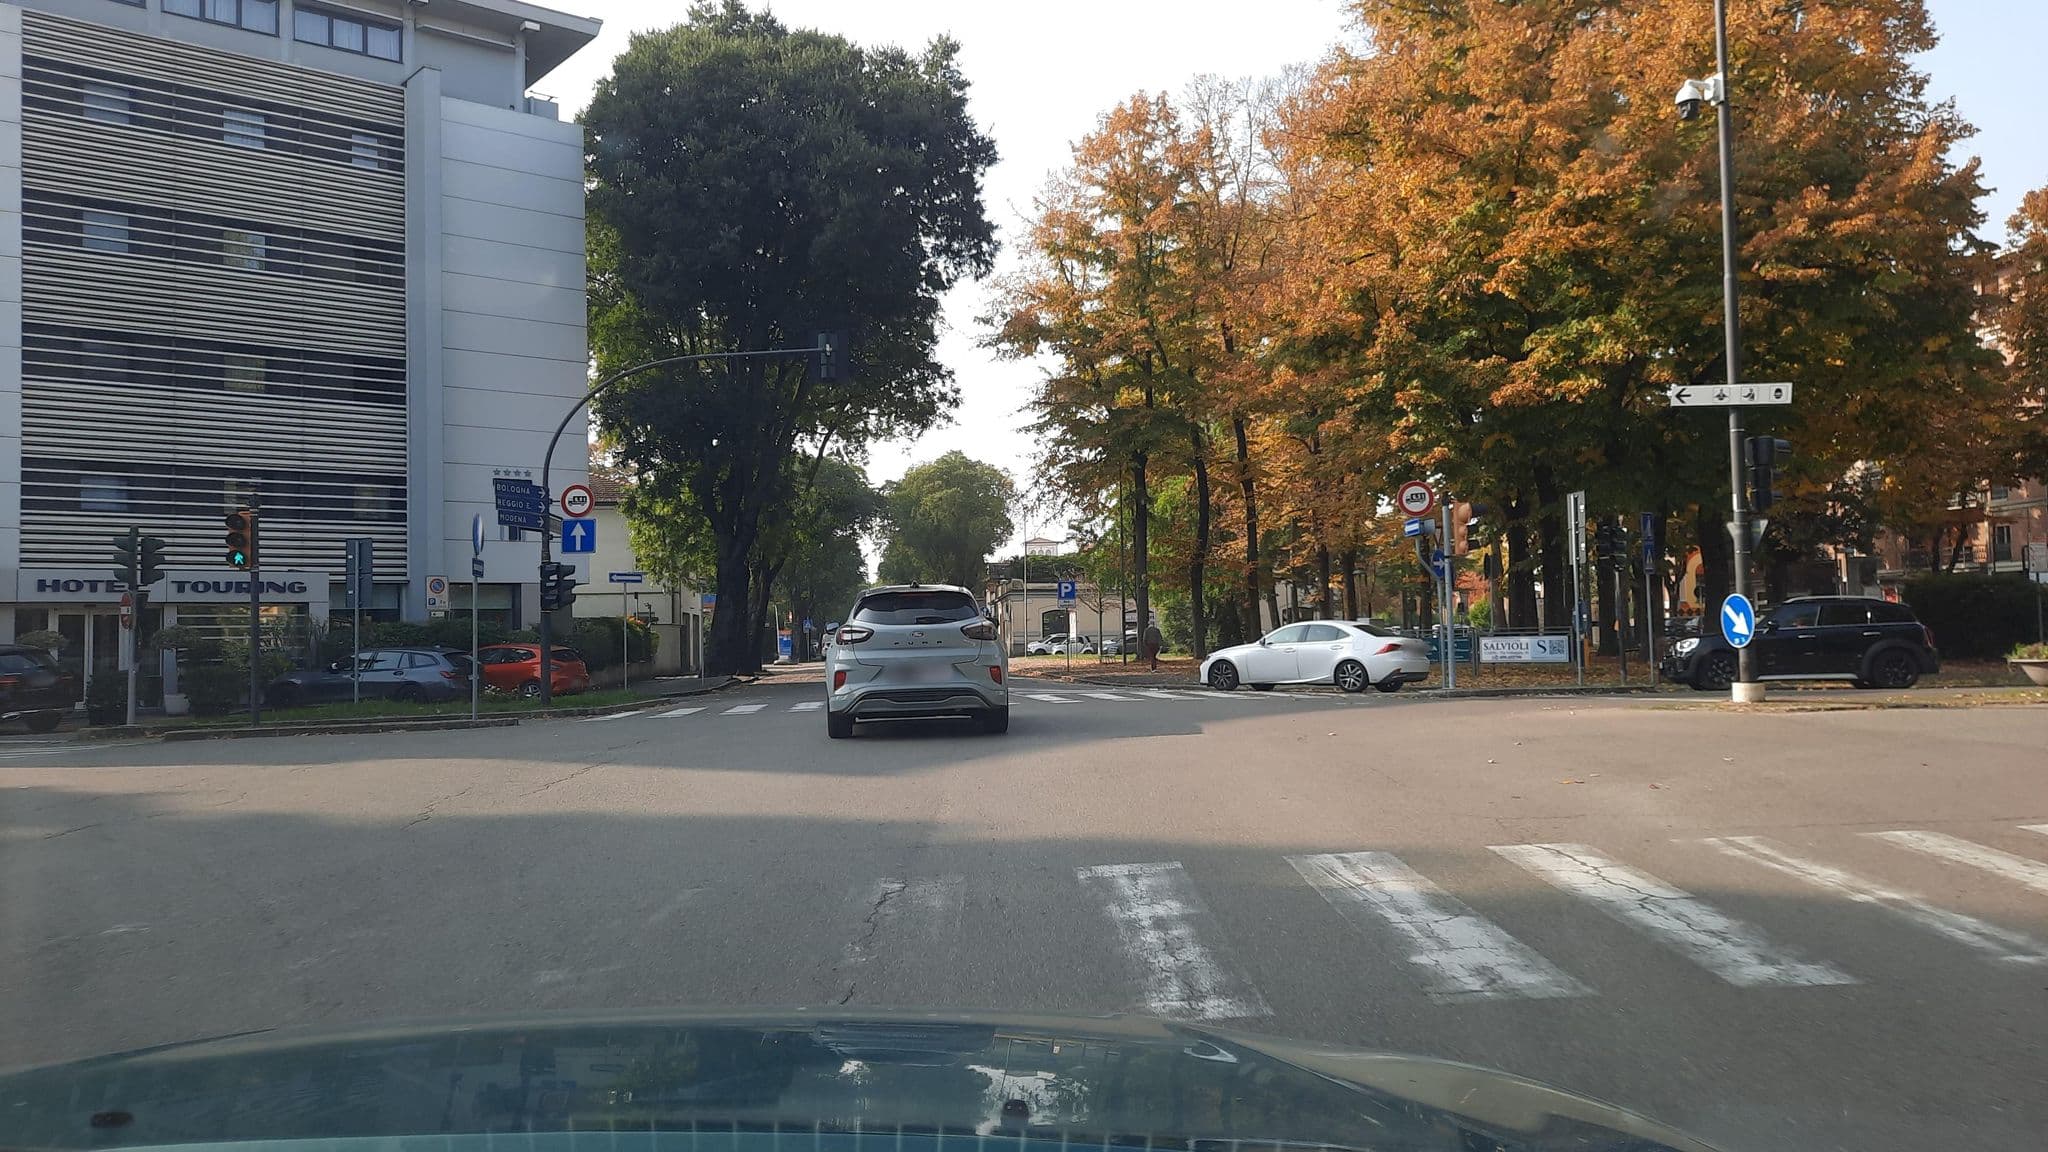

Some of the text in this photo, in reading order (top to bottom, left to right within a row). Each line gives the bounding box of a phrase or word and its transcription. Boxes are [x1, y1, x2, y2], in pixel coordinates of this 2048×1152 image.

[496, 483, 531, 495] BOLOGNA
[497, 498, 524, 509] REGGIO
[500, 514, 527, 524] MODENA
[1061, 582, 1072, 598] P
[1483, 641, 1529, 651] SALVIOLI
